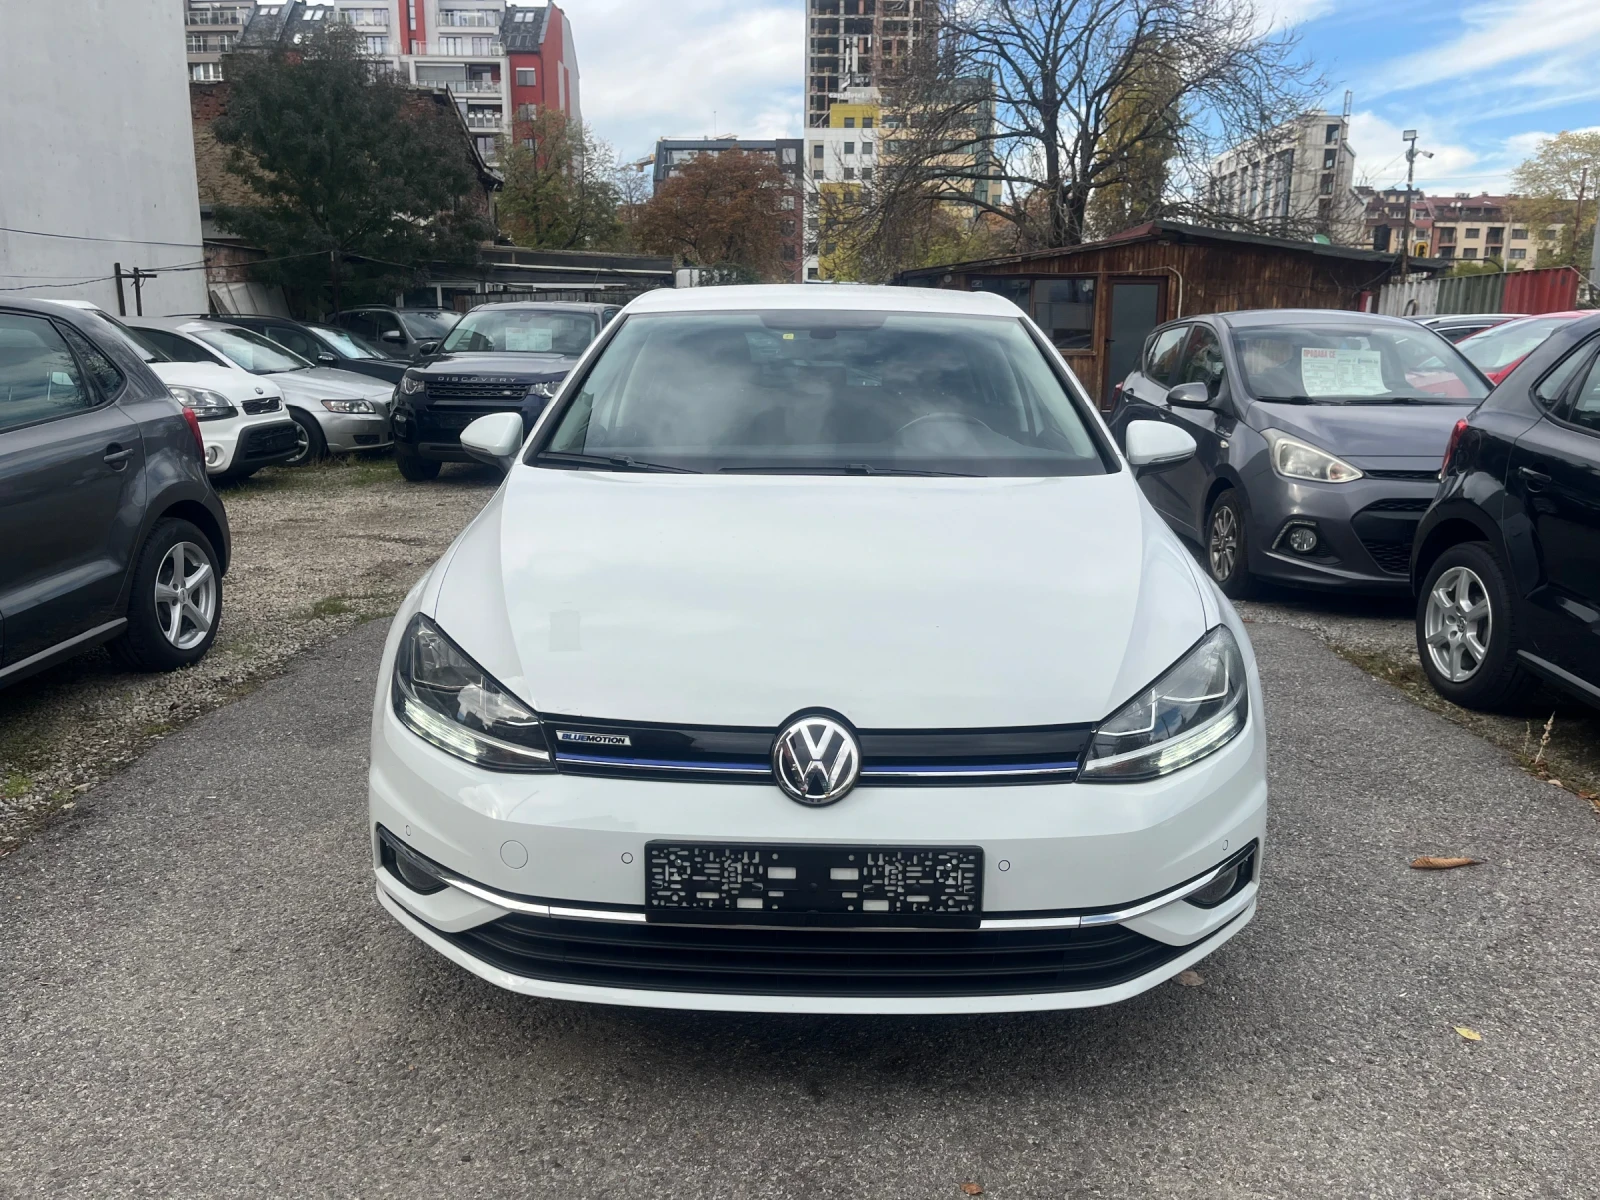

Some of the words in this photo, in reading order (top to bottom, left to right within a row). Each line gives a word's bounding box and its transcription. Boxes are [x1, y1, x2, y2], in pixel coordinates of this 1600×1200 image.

[1303, 349, 1328, 358] ПРОДАВА
[1329, 350, 1336, 358] СЕ
[561, 733, 626, 744] BLUEMOTION
[777, 718, 857, 799] VW
